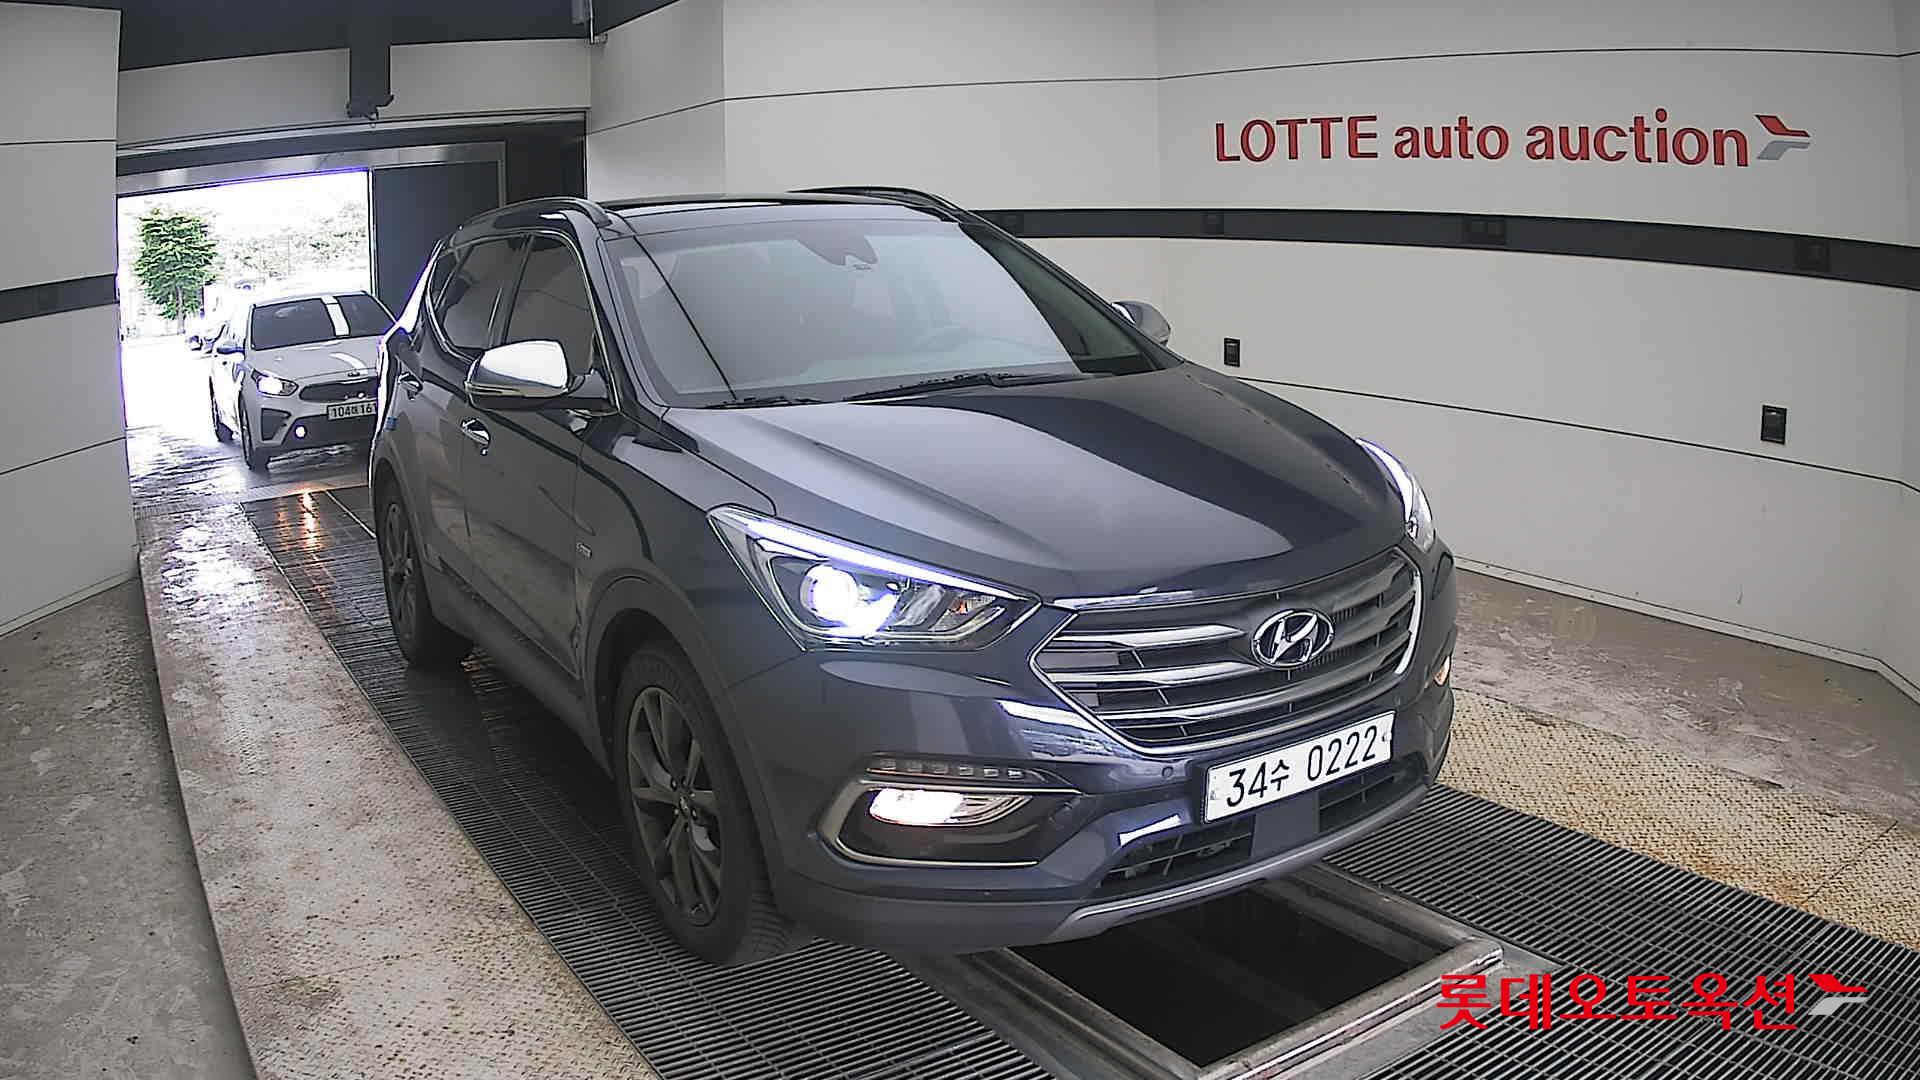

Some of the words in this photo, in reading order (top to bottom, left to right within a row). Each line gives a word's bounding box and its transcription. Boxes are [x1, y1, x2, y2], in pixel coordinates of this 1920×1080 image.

[1216, 115, 1378, 162] LOTTE
[1394, 115, 1510, 160] auto
[1526, 109, 1749, 167] auction
[1226, 758, 1290, 808] 34수
[1307, 725, 1378, 782] 0222
